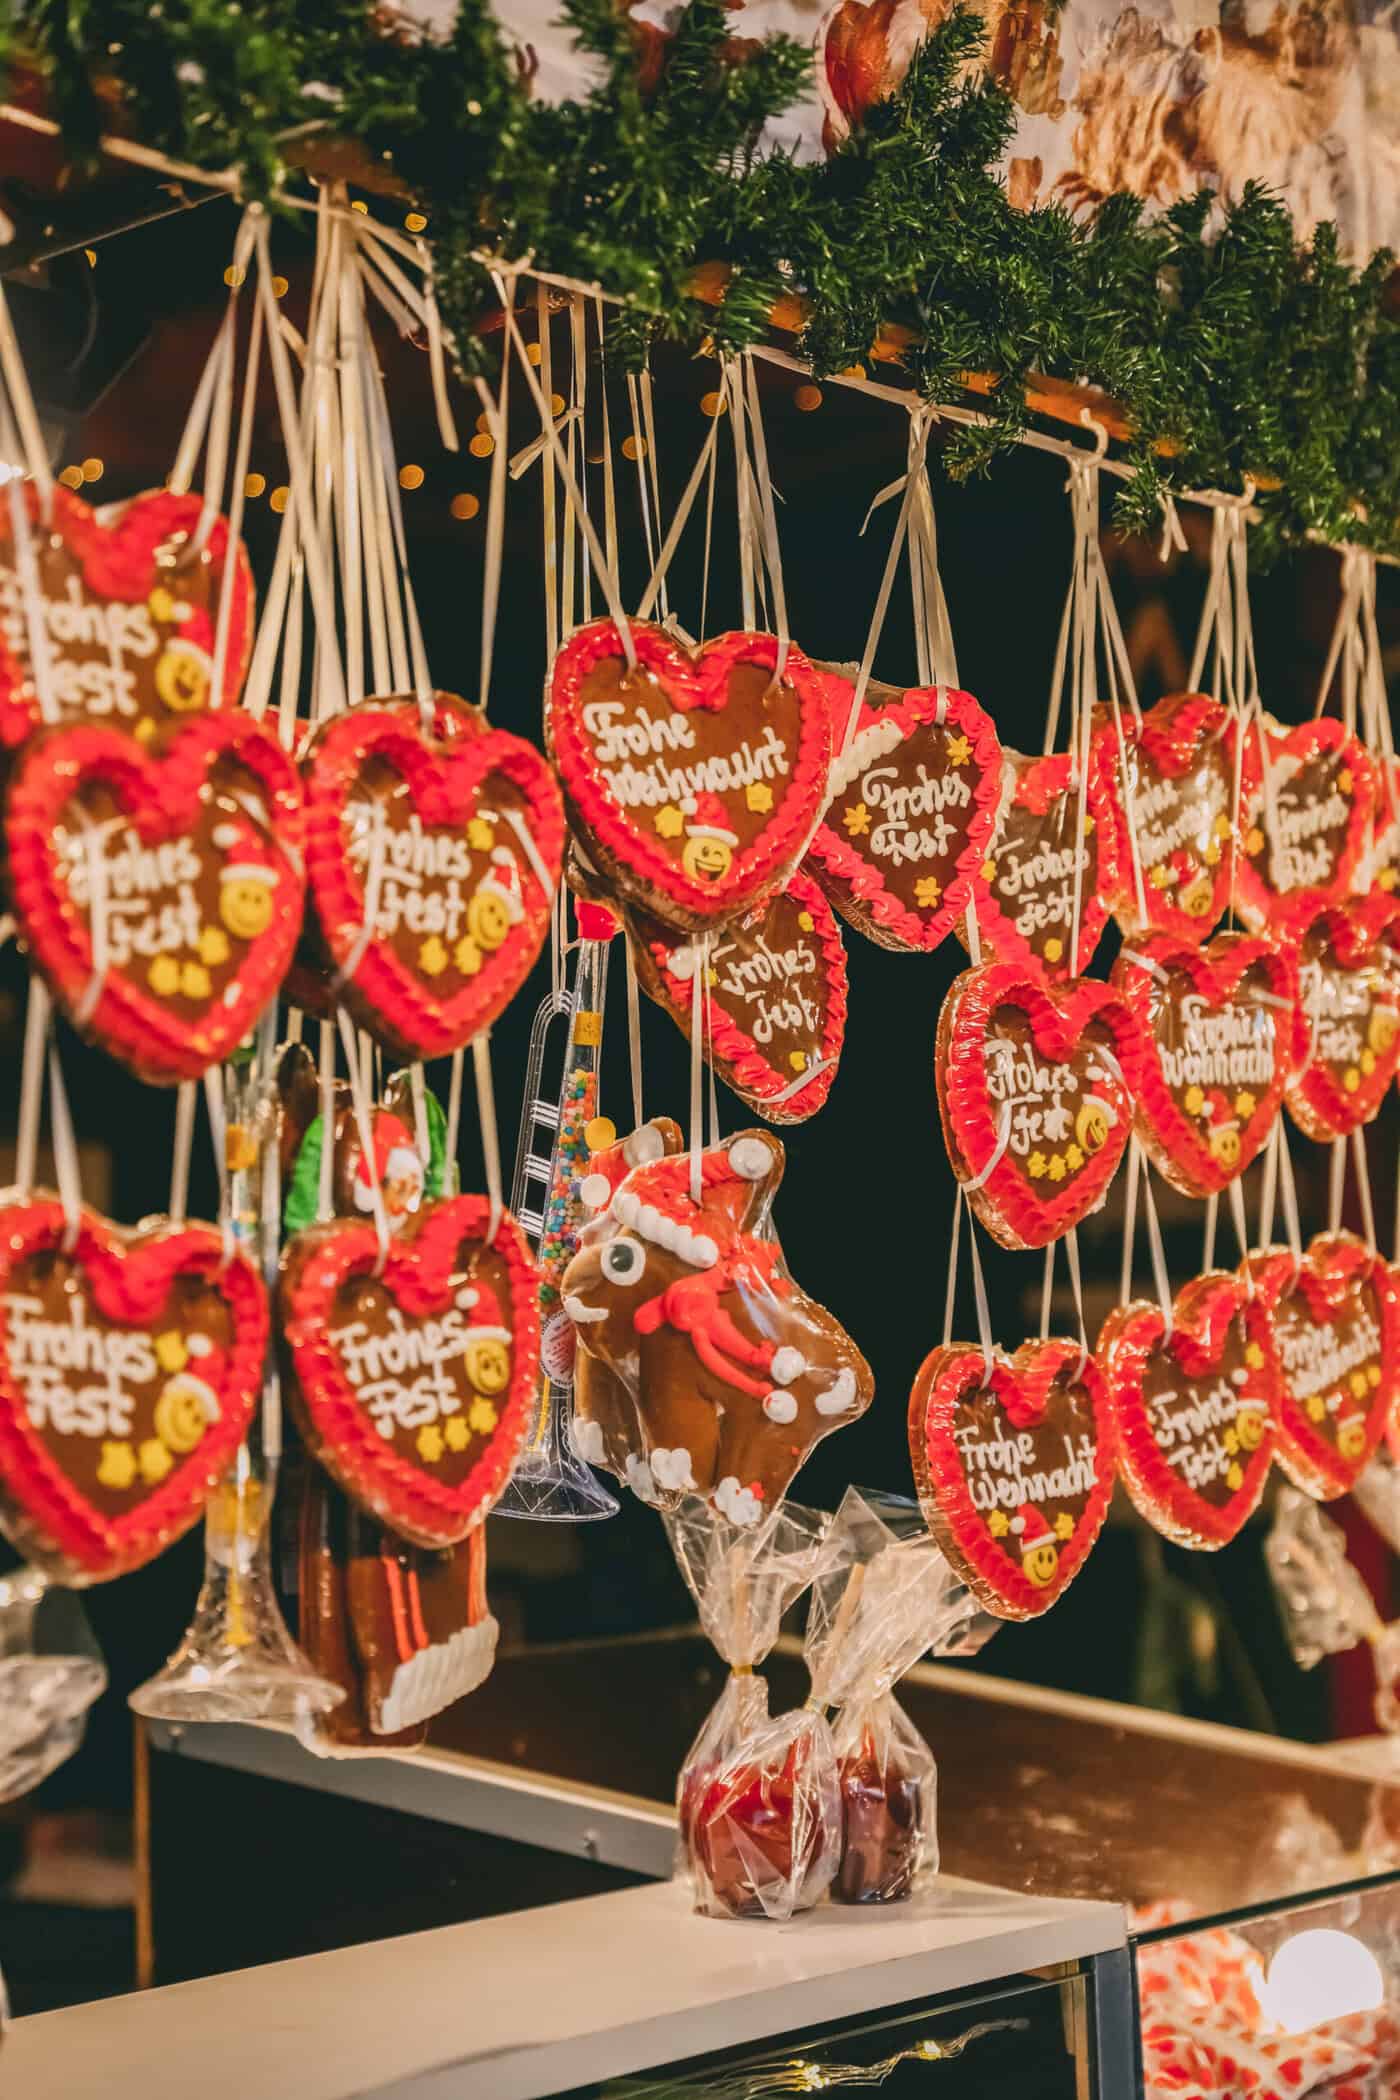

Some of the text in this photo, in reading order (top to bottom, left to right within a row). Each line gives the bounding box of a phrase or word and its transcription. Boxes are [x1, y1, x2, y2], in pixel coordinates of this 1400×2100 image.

[582, 702, 696, 762] Frohe
[862, 764, 971, 822] Frohes
[870, 814, 958, 867] Fest
[711, 934, 816, 996] Frohes
[954, 1416, 1036, 1475] Frohe
